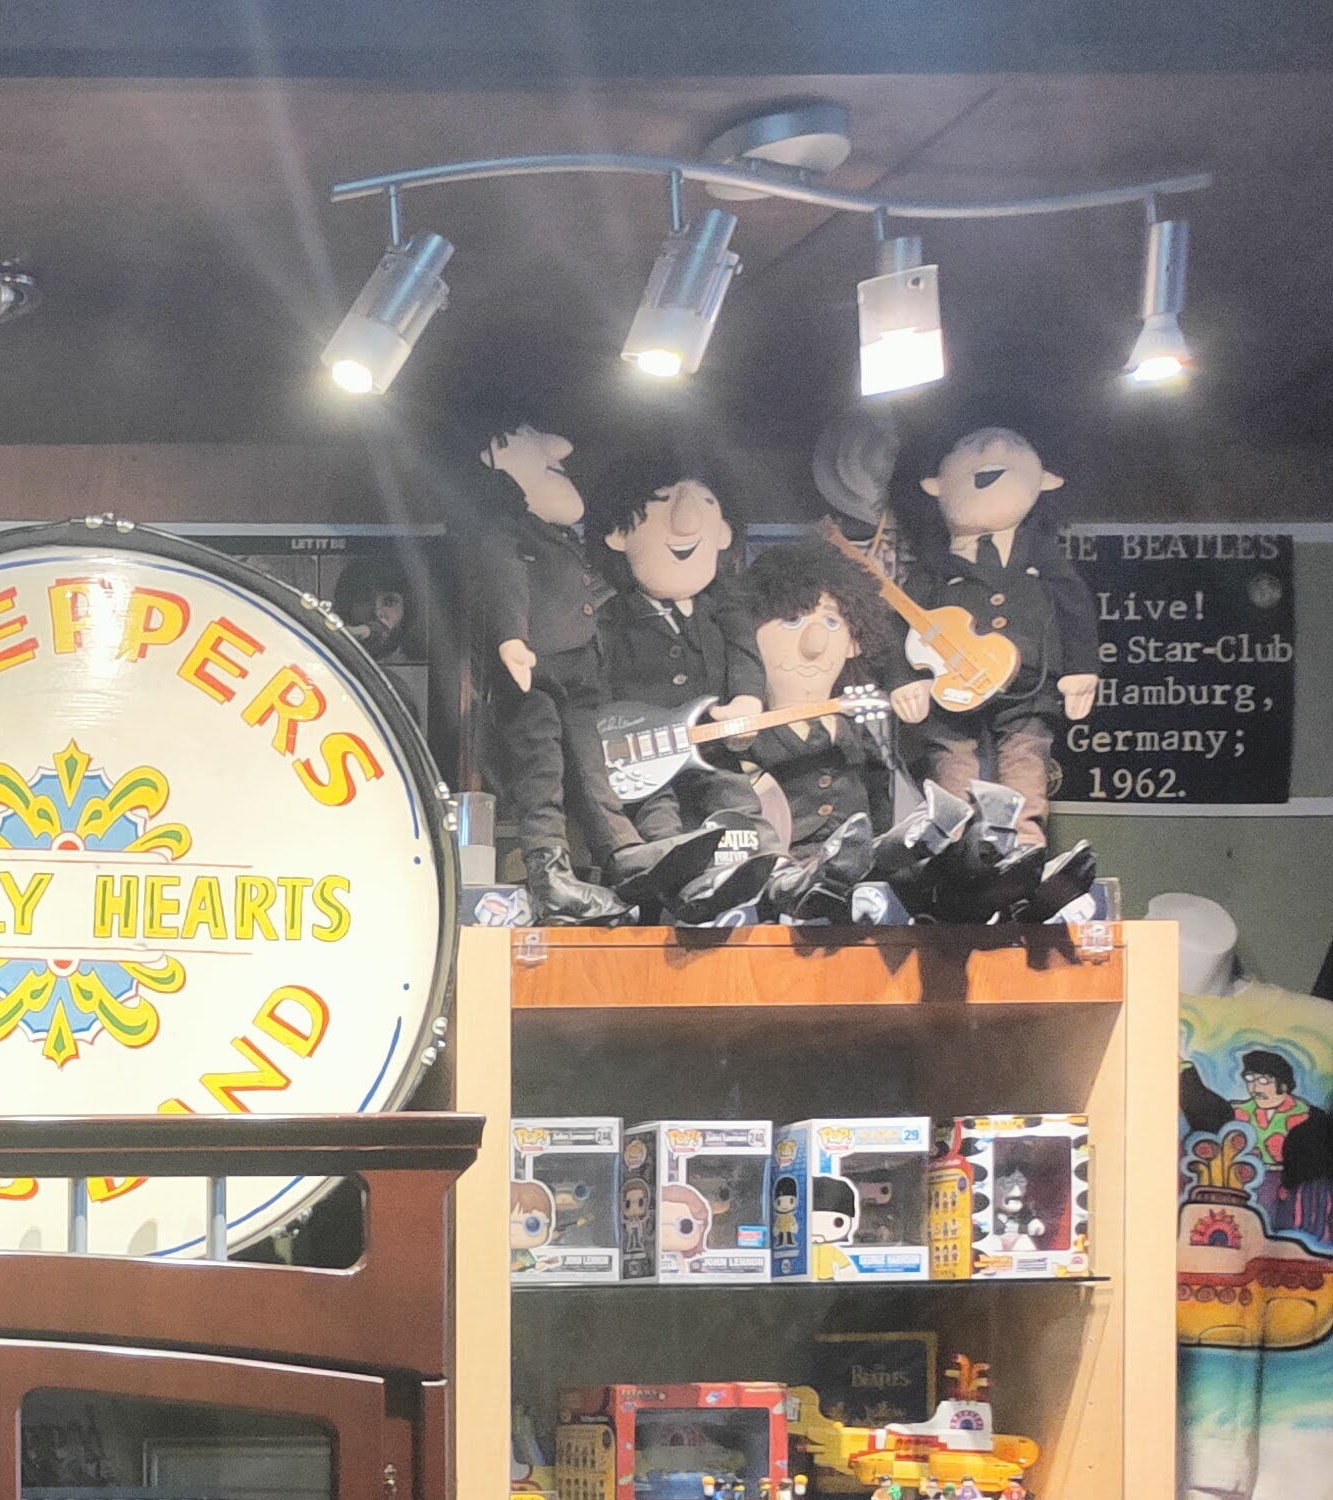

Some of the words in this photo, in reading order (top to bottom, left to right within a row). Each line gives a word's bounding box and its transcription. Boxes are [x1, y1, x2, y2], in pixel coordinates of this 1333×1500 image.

[1058, 533, 1097, 561] HE
[1120, 533, 1279, 560] BEATLES
[1097, 591, 1205, 621] Live!
[1127, 633, 1293, 664] Star-Club
[1096, 676, 1273, 713] Hamburg,
[1067, 724, 1245, 759] Germany;
[1089, 767, 1186, 799] 1962.
[717, 830, 759, 850] EATLES
[93, 874, 352, 943] HEARTS
[903, 1130, 920, 1141] 29
